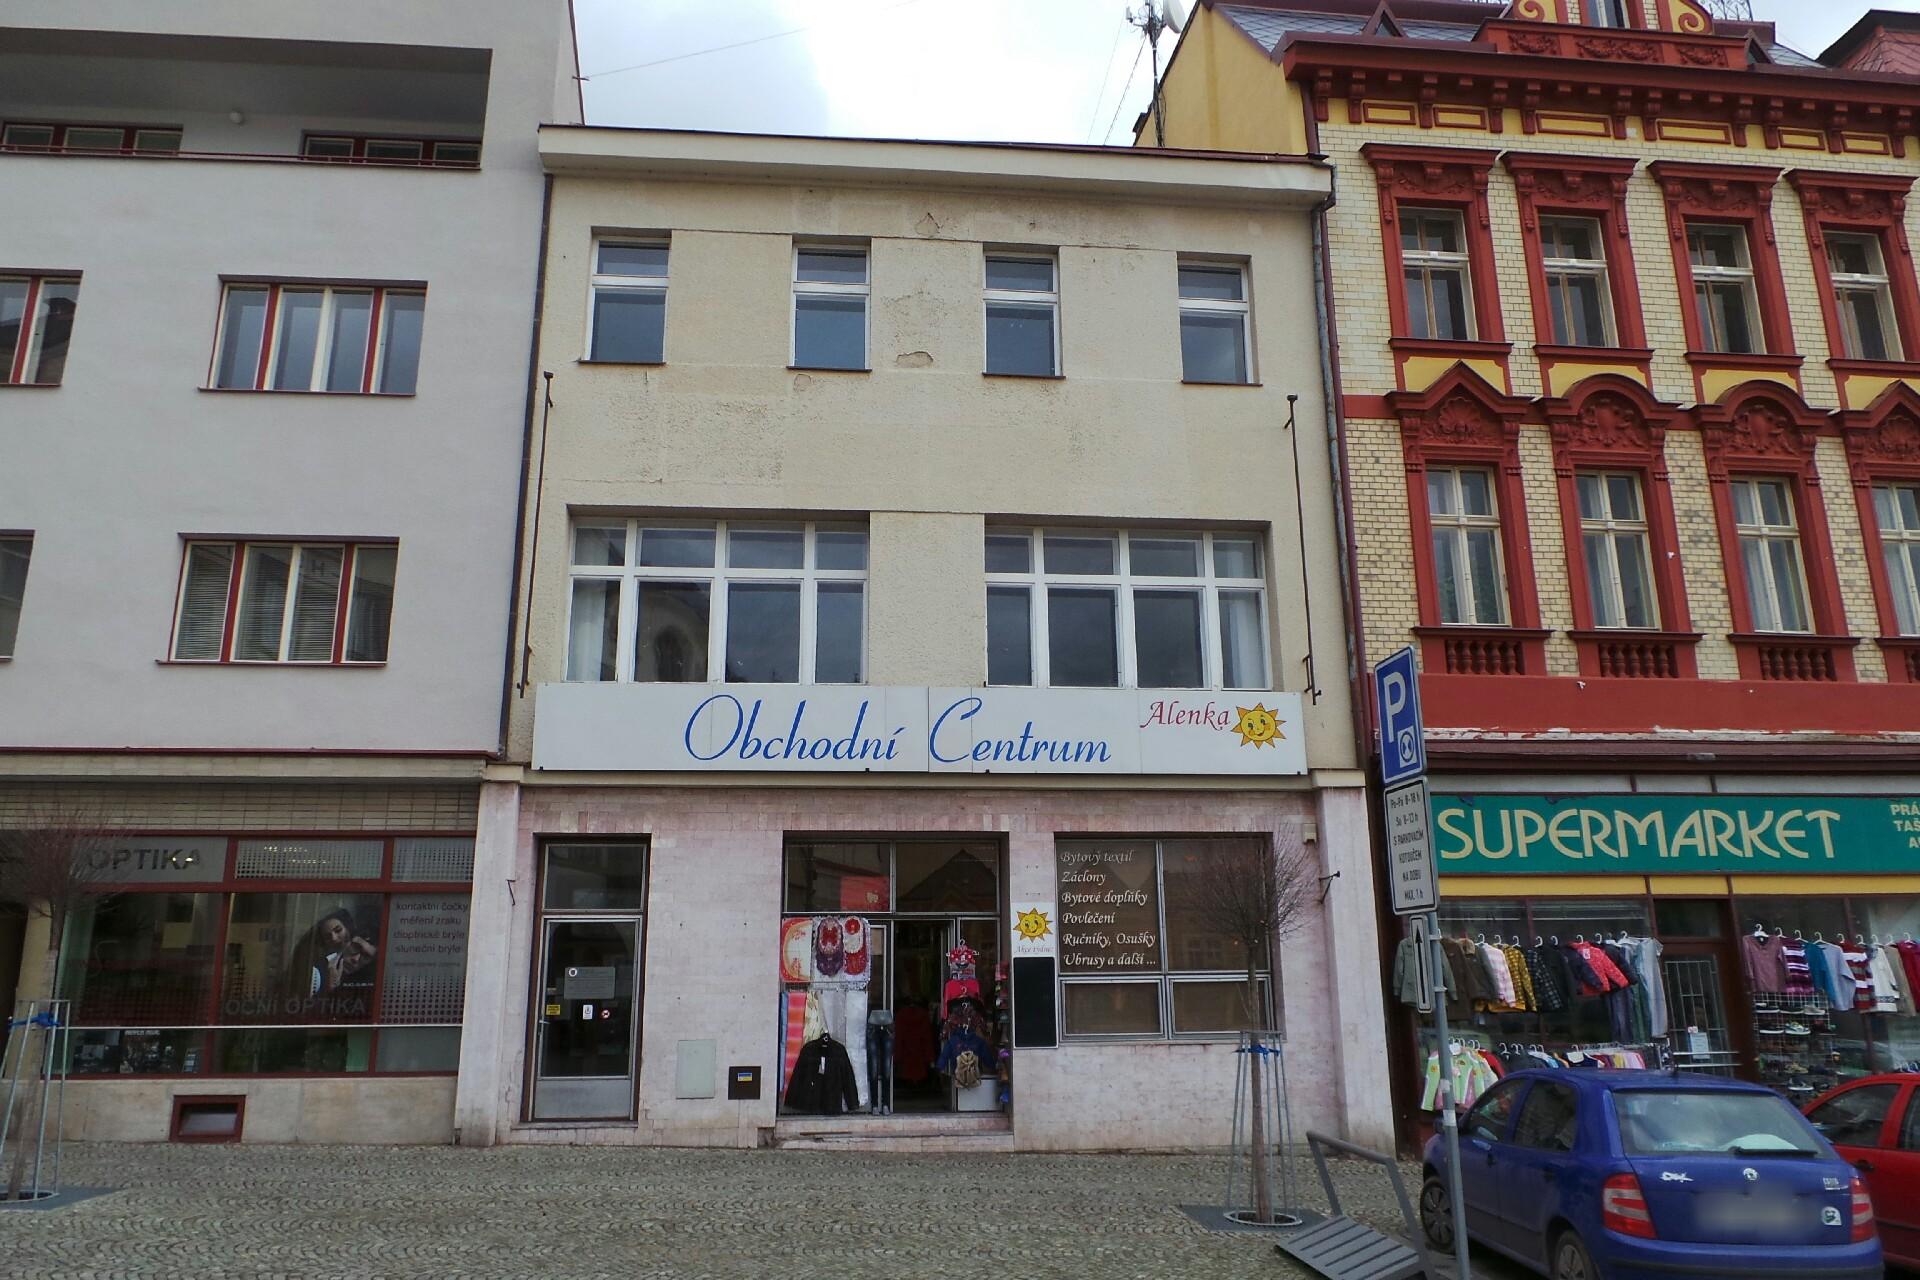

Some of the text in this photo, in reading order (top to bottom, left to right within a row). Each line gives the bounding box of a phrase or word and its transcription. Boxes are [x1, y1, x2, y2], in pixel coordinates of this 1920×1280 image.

[1383, 671, 1406, 744] P
[1140, 701, 1230, 732] Alenka
[684, 694, 1111, 763] Obchodní Centrum
[1437, 808, 1841, 859] SUPERMARKET
[88, 848, 201, 870] OPTIKA
[1061, 849, 1133, 866] Bytový textil
[1061, 870, 1106, 886] Záclony
[1061, 890, 1148, 907] Bytové doplňky
[1062, 911, 1115, 924] Povlečení
[1063, 931, 1156, 948] Ručníky, Osušky
[1063, 953, 1106, 969] Ubrusy
[1107, 957, 1114, 966] a
[1117, 952, 1144, 965] další
